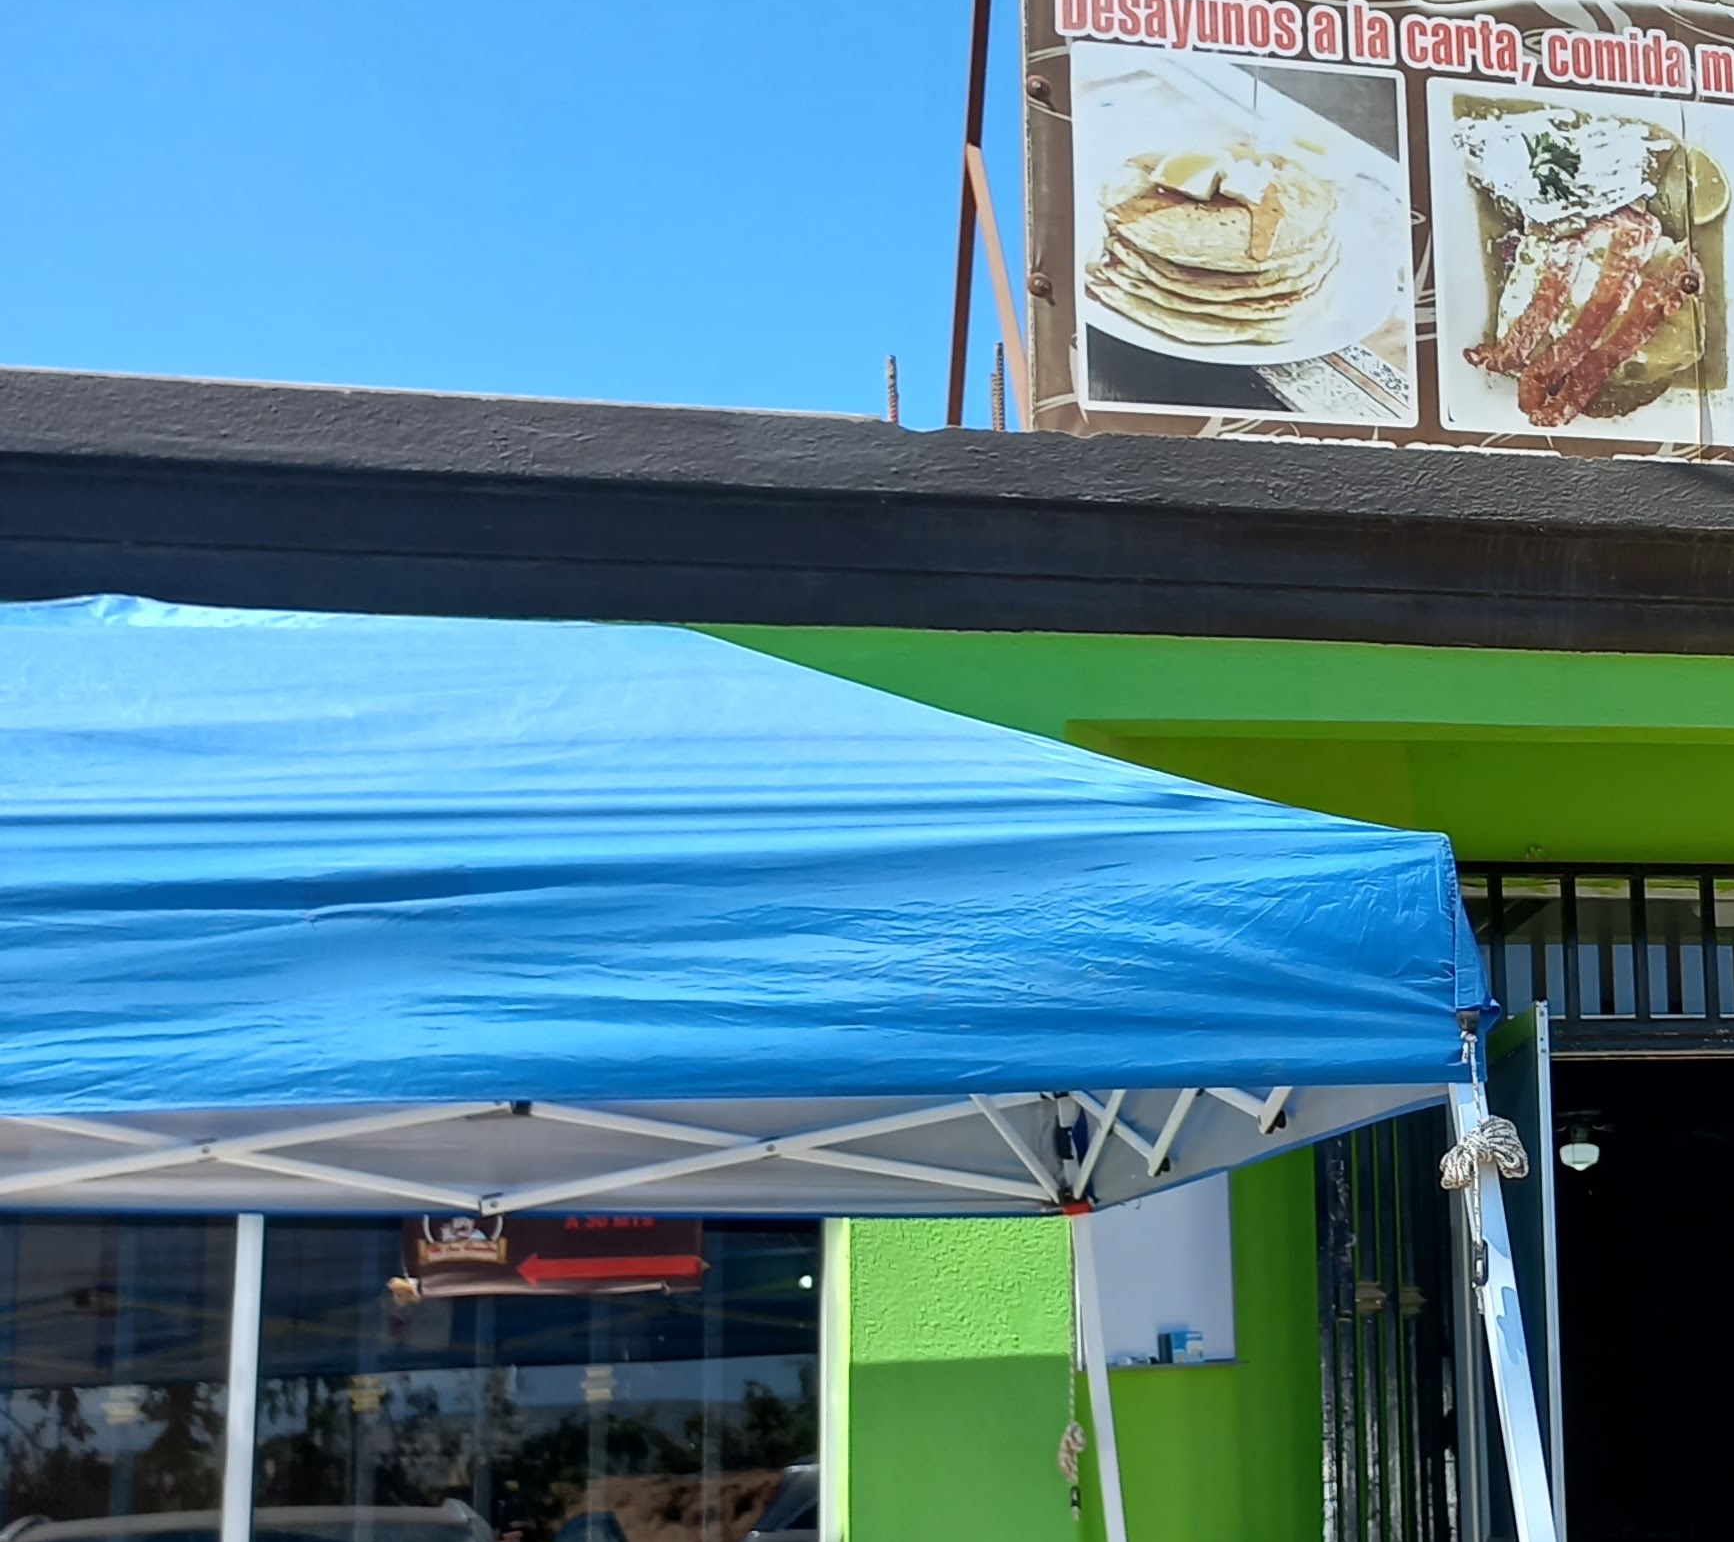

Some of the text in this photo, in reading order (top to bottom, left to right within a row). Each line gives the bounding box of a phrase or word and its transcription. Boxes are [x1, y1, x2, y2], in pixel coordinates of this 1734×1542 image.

[1313, 11, 1337, 55] a
[1354, 4, 1390, 60] la
[1406, 19, 1532, 82] carta,
[1547, 31, 1687, 89] comida
